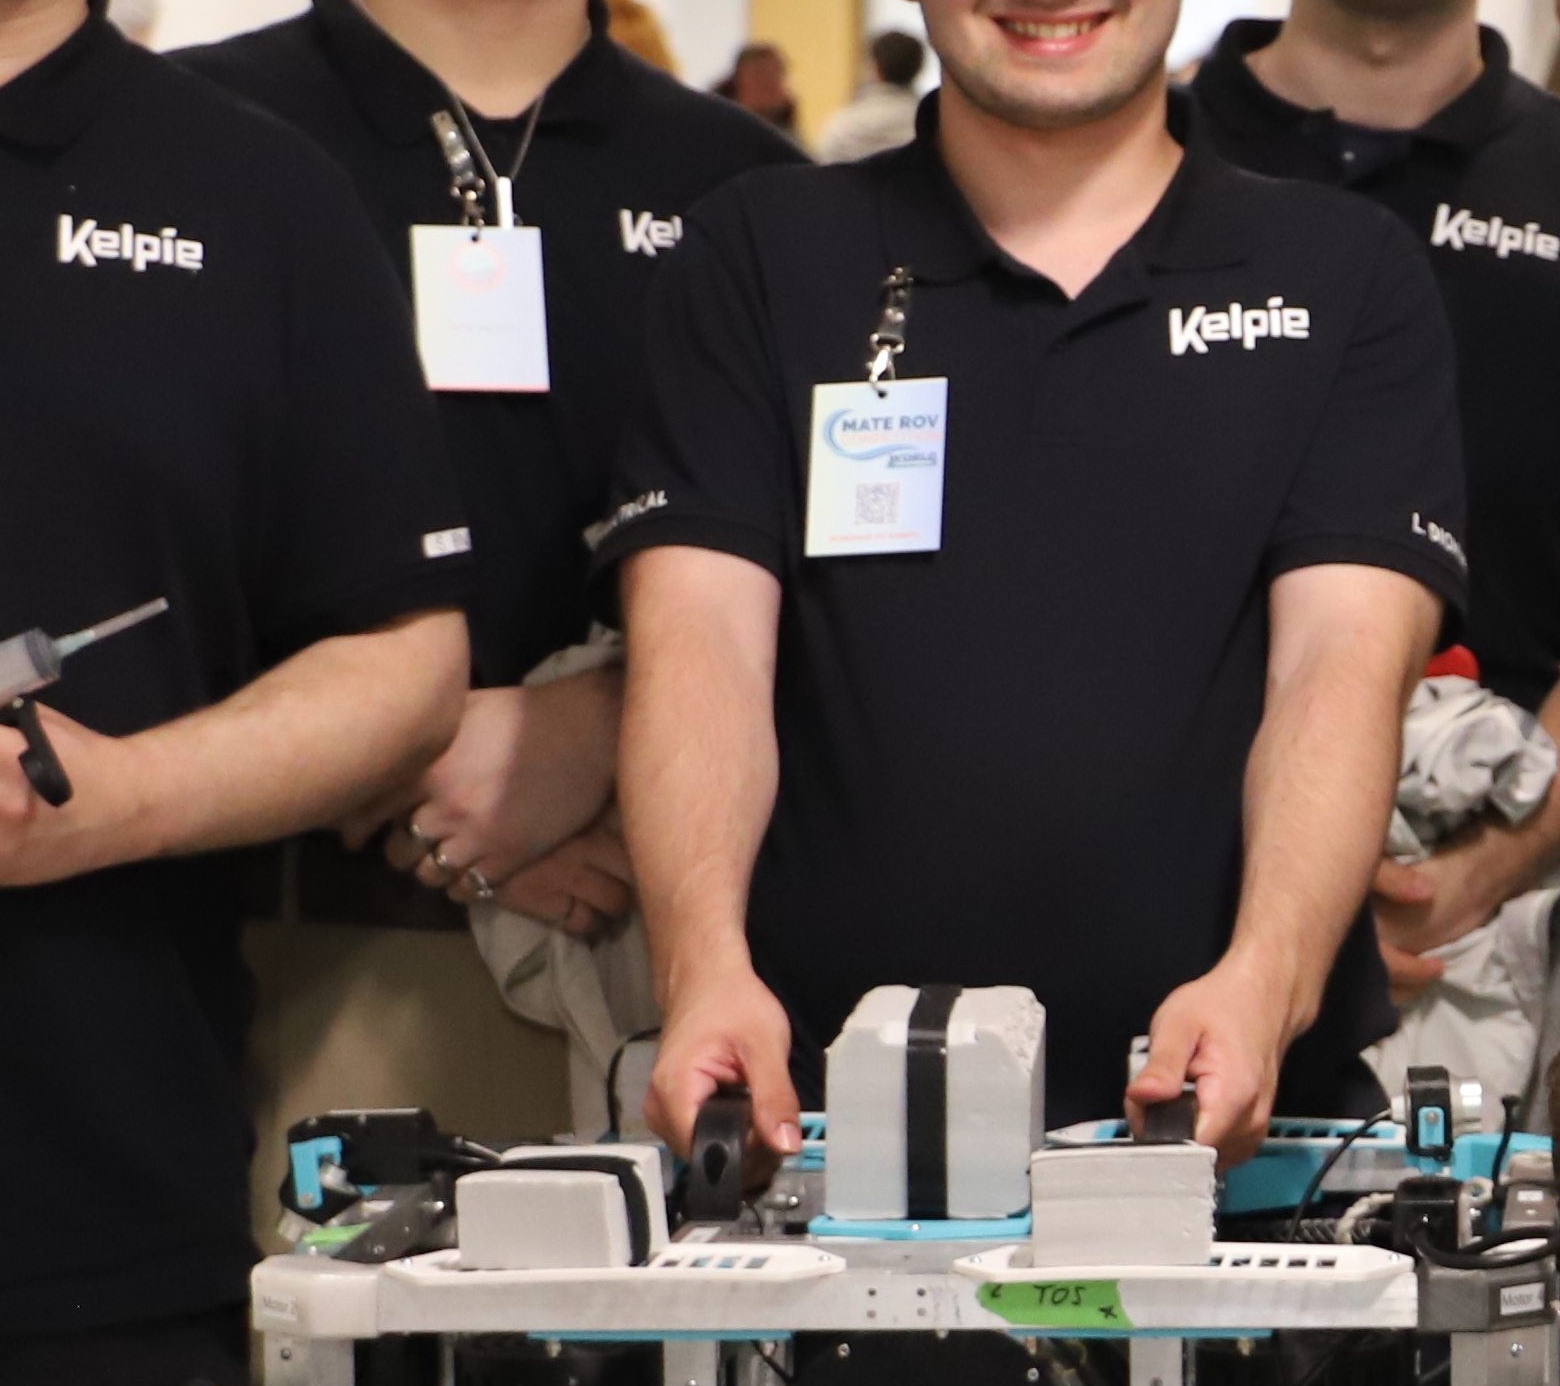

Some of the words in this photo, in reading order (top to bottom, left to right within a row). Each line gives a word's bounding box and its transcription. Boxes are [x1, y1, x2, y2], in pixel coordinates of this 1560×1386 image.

[57, 213, 204, 272] Kelpie
[1431, 203, 1560, 261] Kelpie
[1169, 296, 1310, 356] Kelpie
[843, 416, 893, 432] MATE
[900, 414, 939, 429] ROV
[1033, 1284, 1086, 1306] TOS
